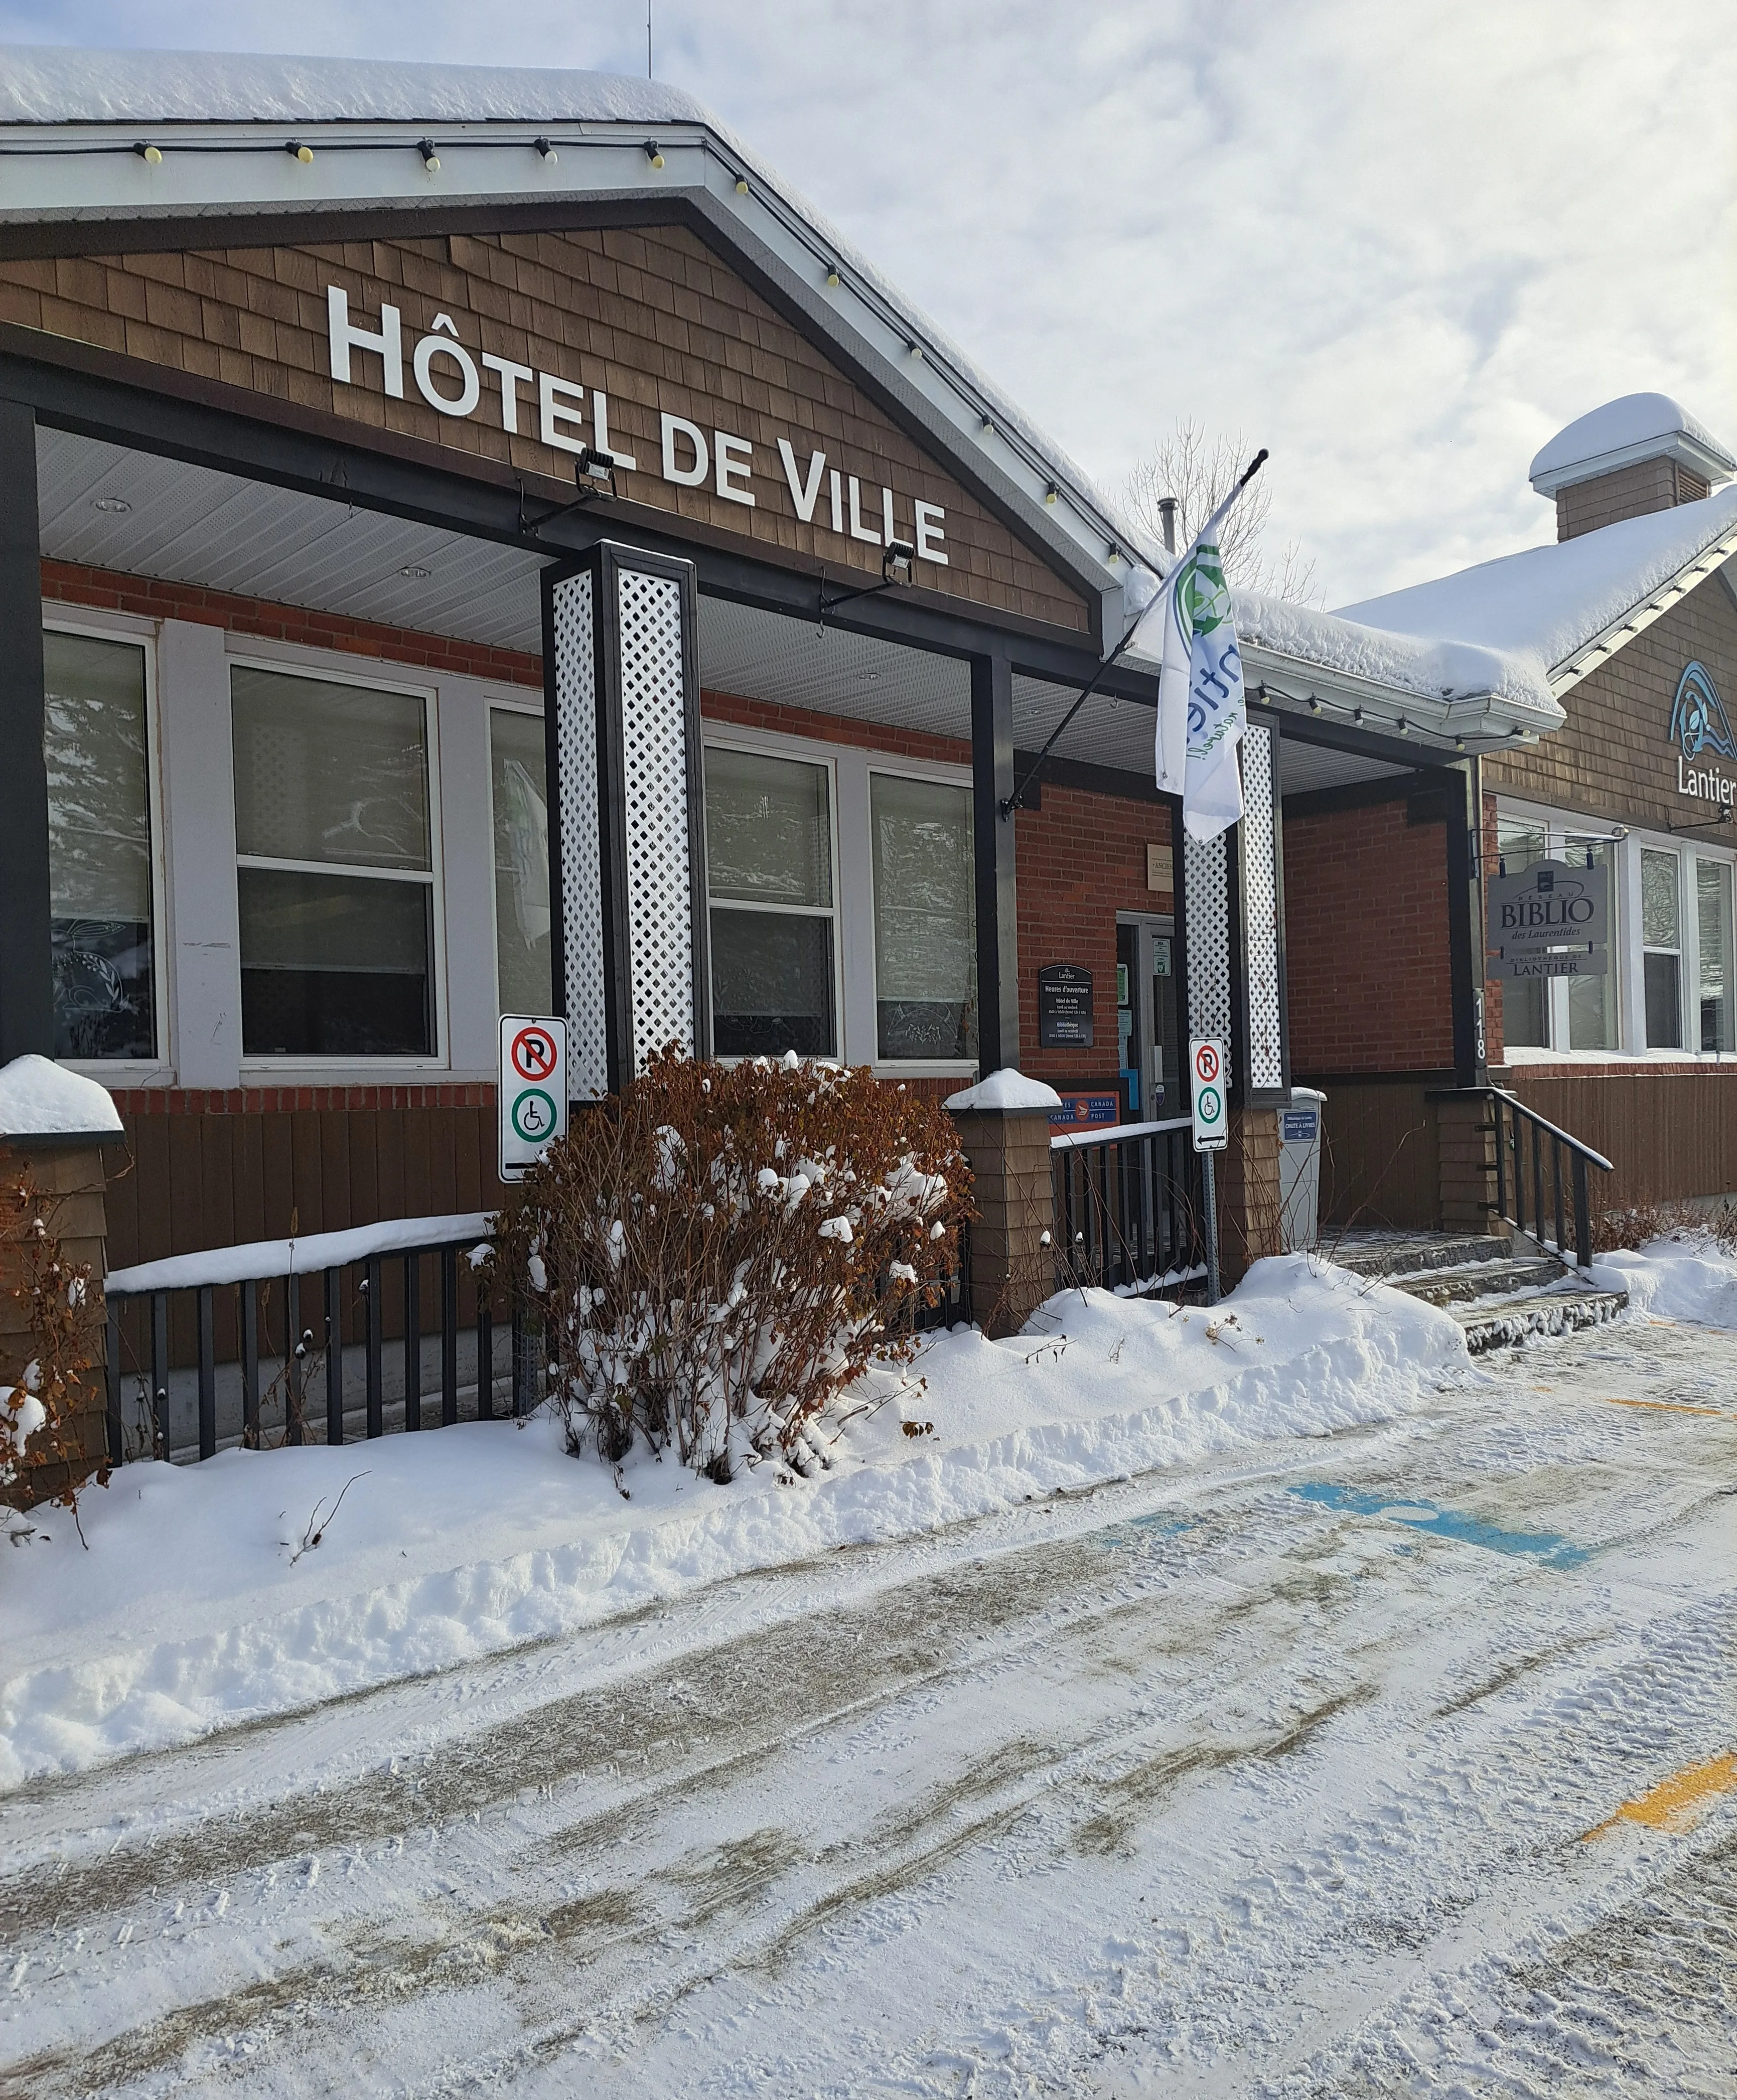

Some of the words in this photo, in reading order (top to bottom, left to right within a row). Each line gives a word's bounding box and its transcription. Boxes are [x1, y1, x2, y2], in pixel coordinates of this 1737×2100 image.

[327, 284, 637, 472] HÔTEL
[661, 411, 756, 508] DE
[777, 437, 949, 566] VILLE
[1678, 755, 1737, 806] Lantier
[1500, 898, 1595, 928] BIBLIO
[1512, 931, 1526, 940] des
[1528, 927, 1581, 939] Laurentides
[1059, 971, 1075, 980] Lantier
[1514, 962, 1580, 976] LANTIER
[1045, 985, 1062, 993] Heures
[1062, 986, 1089, 994] d'ouverture
[1476, 997, 1486, 1060] 118
